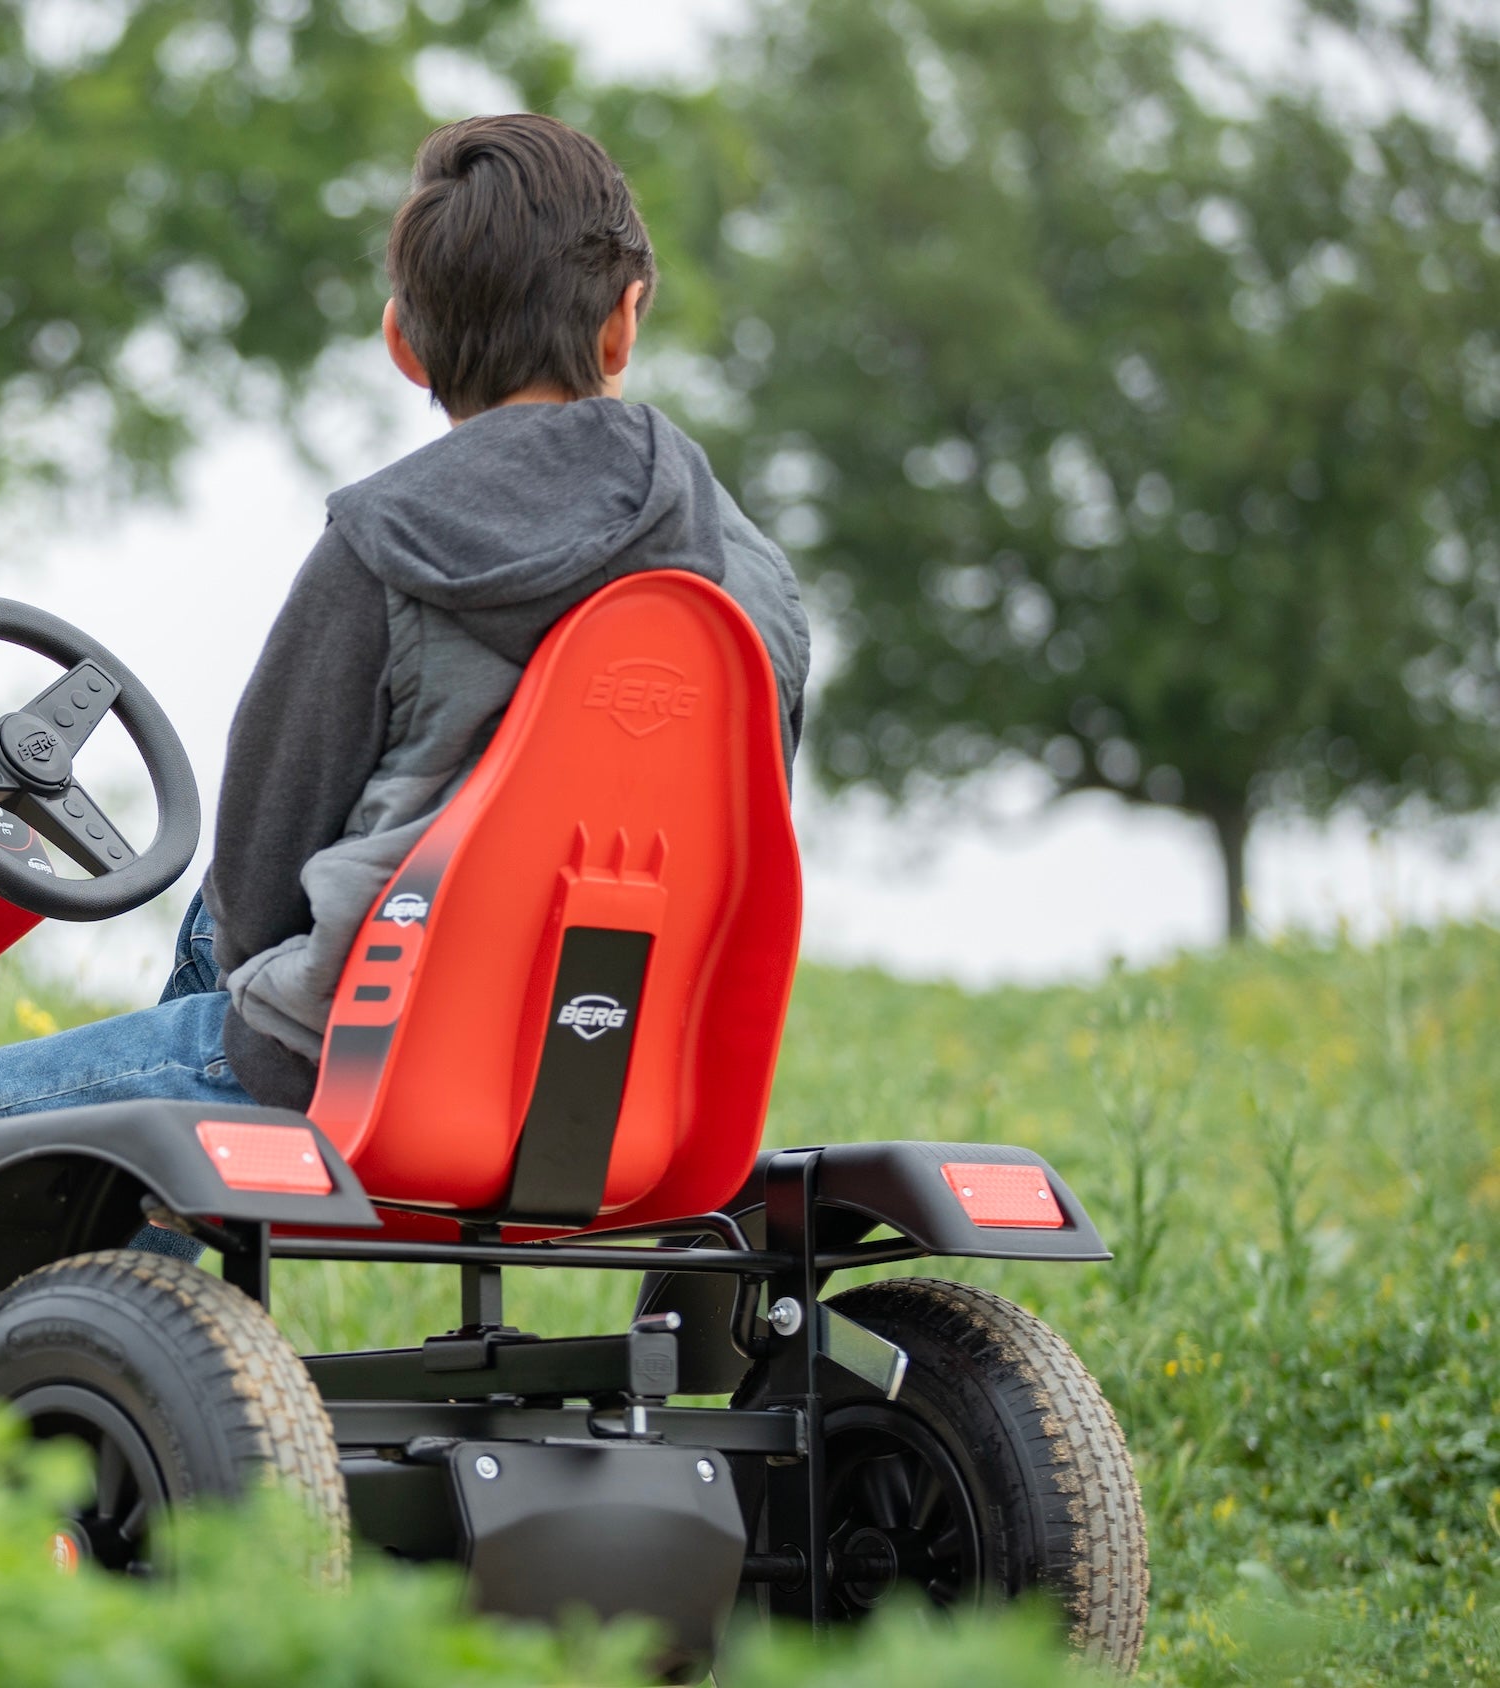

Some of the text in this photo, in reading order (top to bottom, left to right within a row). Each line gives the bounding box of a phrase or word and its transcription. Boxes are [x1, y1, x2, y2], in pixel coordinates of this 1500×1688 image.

[582, 675, 700, 719] BERG
[17, 735, 59, 762] BERG
[27, 860, 52, 874] BERG
[383, 902, 428, 918] BERG
[557, 1005, 628, 1028] BERG
